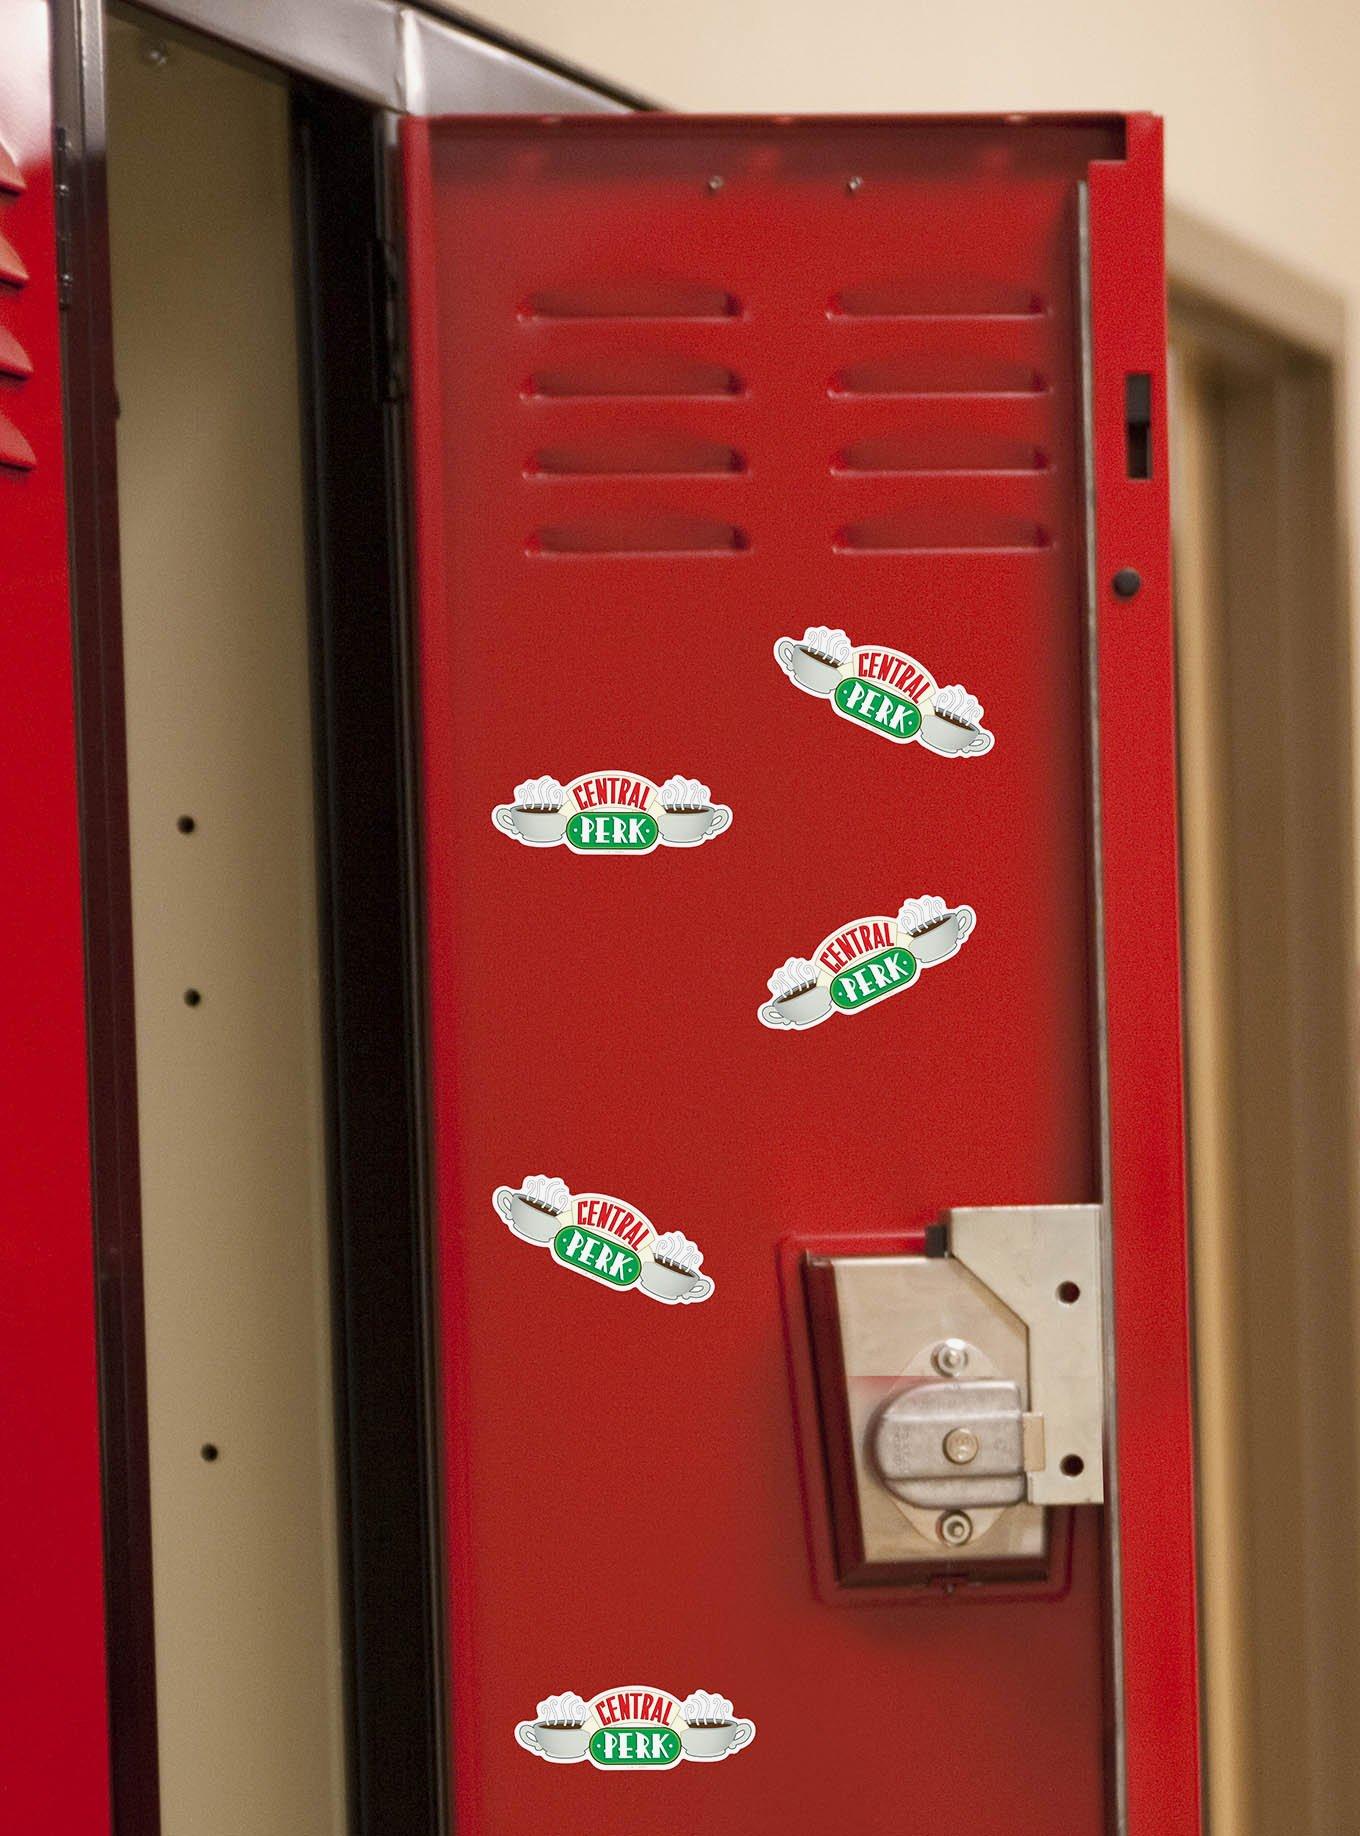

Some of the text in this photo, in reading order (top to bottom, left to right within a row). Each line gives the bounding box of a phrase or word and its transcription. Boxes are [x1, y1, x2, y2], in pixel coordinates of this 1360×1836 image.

[858, 652, 931, 705] CENTRAL
[846, 682, 913, 733] PERK
[572, 777, 651, 811] CENTRAL
[580, 816, 647, 843] PERK
[819, 922, 895, 974] CENTRAL
[839, 952, 909, 1002] PERK
[577, 1200, 651, 1251] CENTRAL
[565, 1230, 634, 1280] PERK
[595, 1693, 673, 1726] CENTRAL
[603, 1731, 670, 1759] PERK
